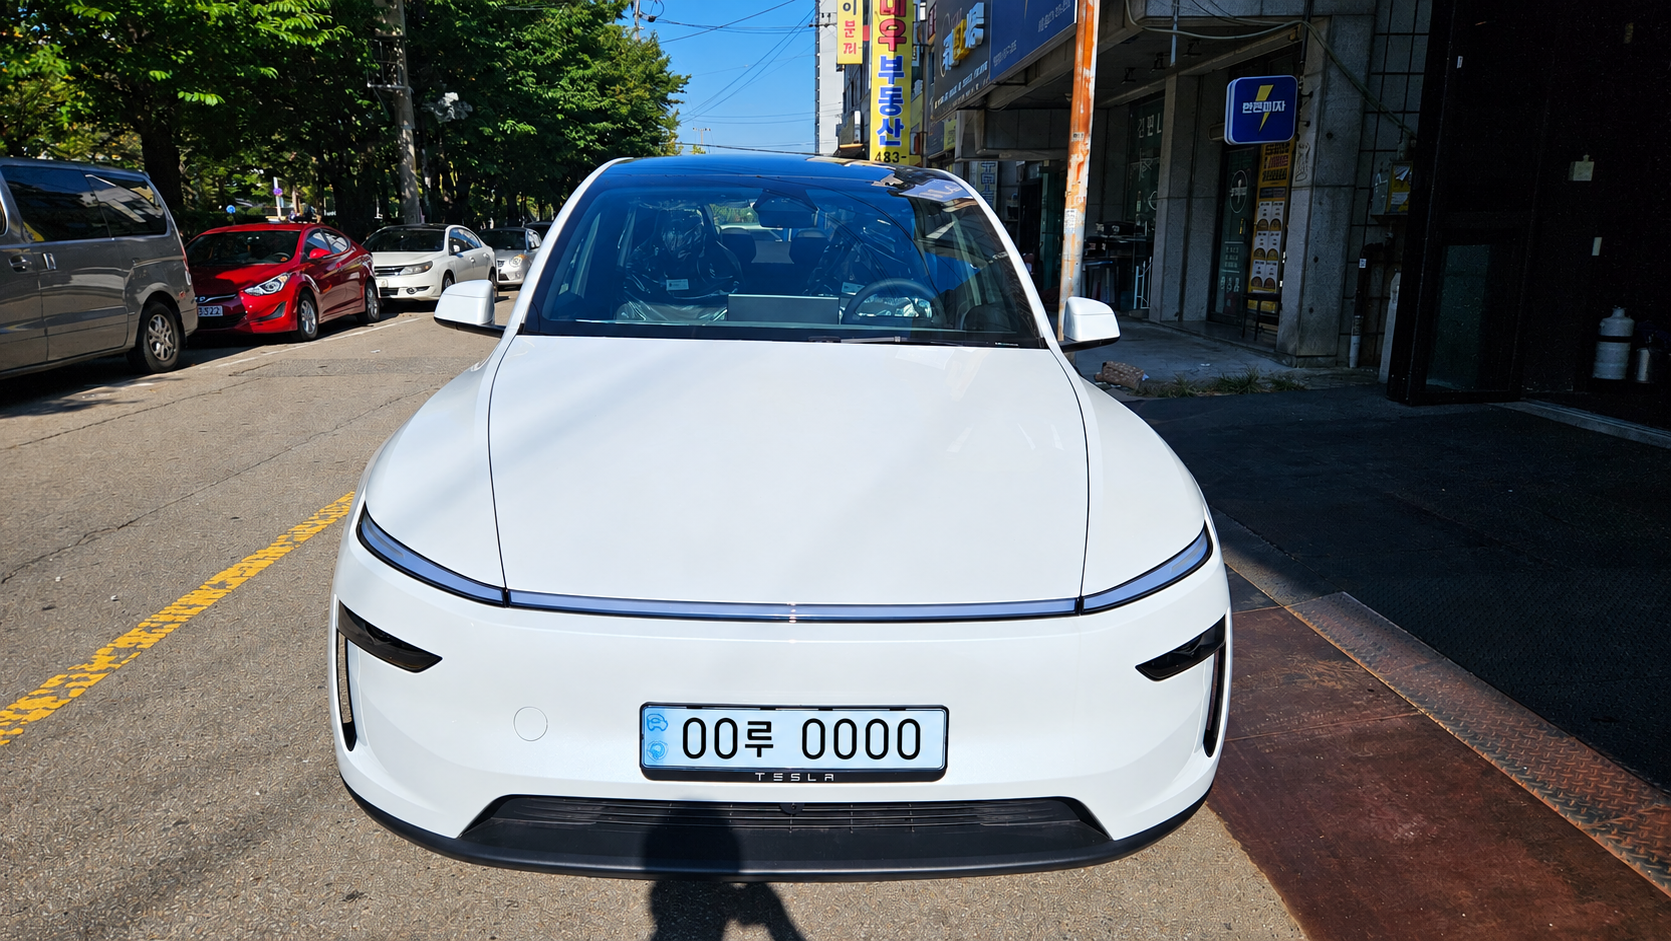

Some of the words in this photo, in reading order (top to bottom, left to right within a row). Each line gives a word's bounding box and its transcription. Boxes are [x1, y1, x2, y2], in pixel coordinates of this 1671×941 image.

[682, 717, 774, 760] 00루
[801, 717, 921, 760] 0000
[755, 772, 834, 782] TESLA
